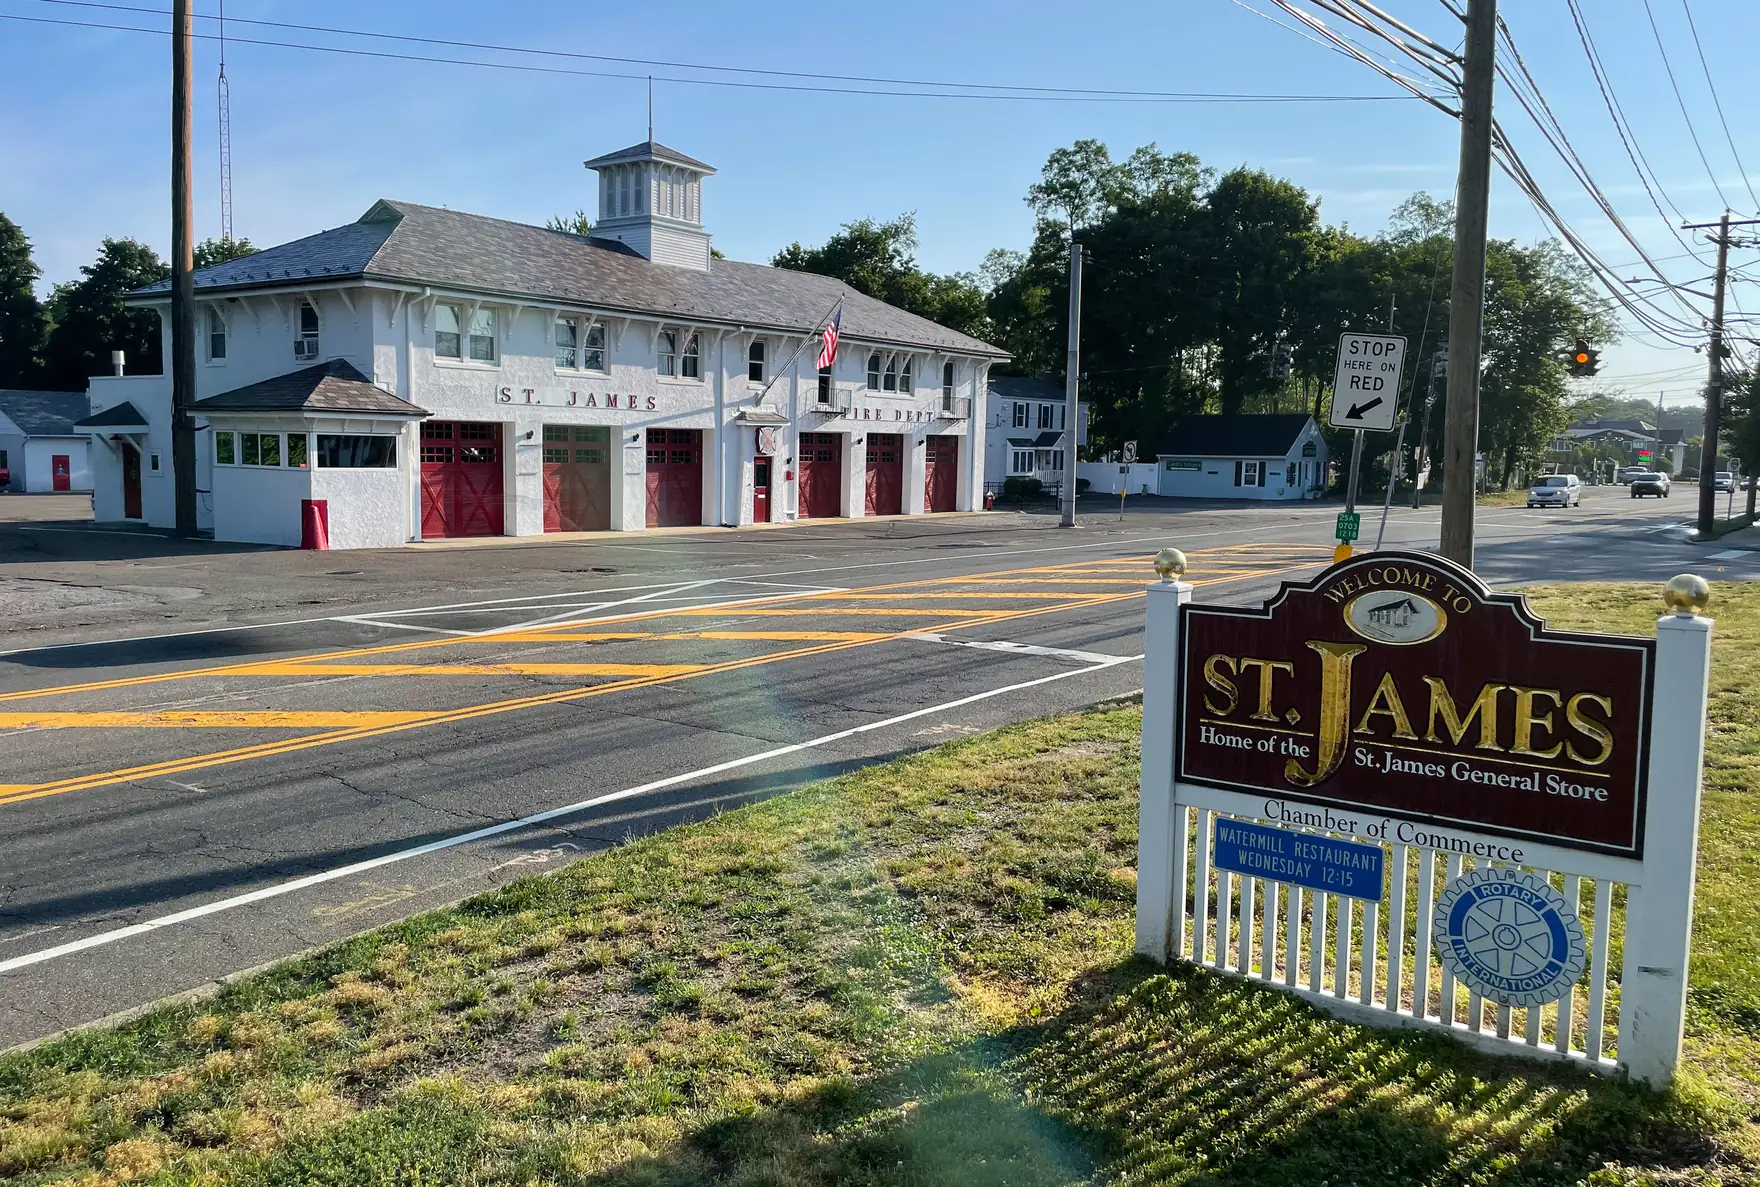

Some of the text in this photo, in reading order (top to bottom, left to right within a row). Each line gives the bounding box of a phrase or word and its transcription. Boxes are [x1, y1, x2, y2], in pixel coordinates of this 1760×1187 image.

[1349, 340, 1396, 357] STOP
[1344, 360, 1396, 373] HERE ON
[1350, 375, 1384, 391] RED
[501, 387, 656, 410] ST. JAMES
[842, 406, 882, 420] FIRE
[1338, 522, 1358, 530] 0703
[1323, 567, 1472, 614] WELCOME TO
[1203, 640, 1614, 787] ST. JAMES
[1200, 726, 1253, 750] Home
[1257, 735, 1278, 753] of
[1280, 738, 1311, 758] the
[1451, 761, 1541, 793] General
[1546, 774, 1609, 802] Store
[1264, 799, 1525, 864] Chamber of Commerce
[1219, 826, 1378, 873] WATERMILL RESTAURANT
[1238, 850, 1354, 888] WEDNESDAY 12:15
[1481, 884, 1541, 906] ROTARY
[1455, 943, 1558, 991] INTERNATIONAL
